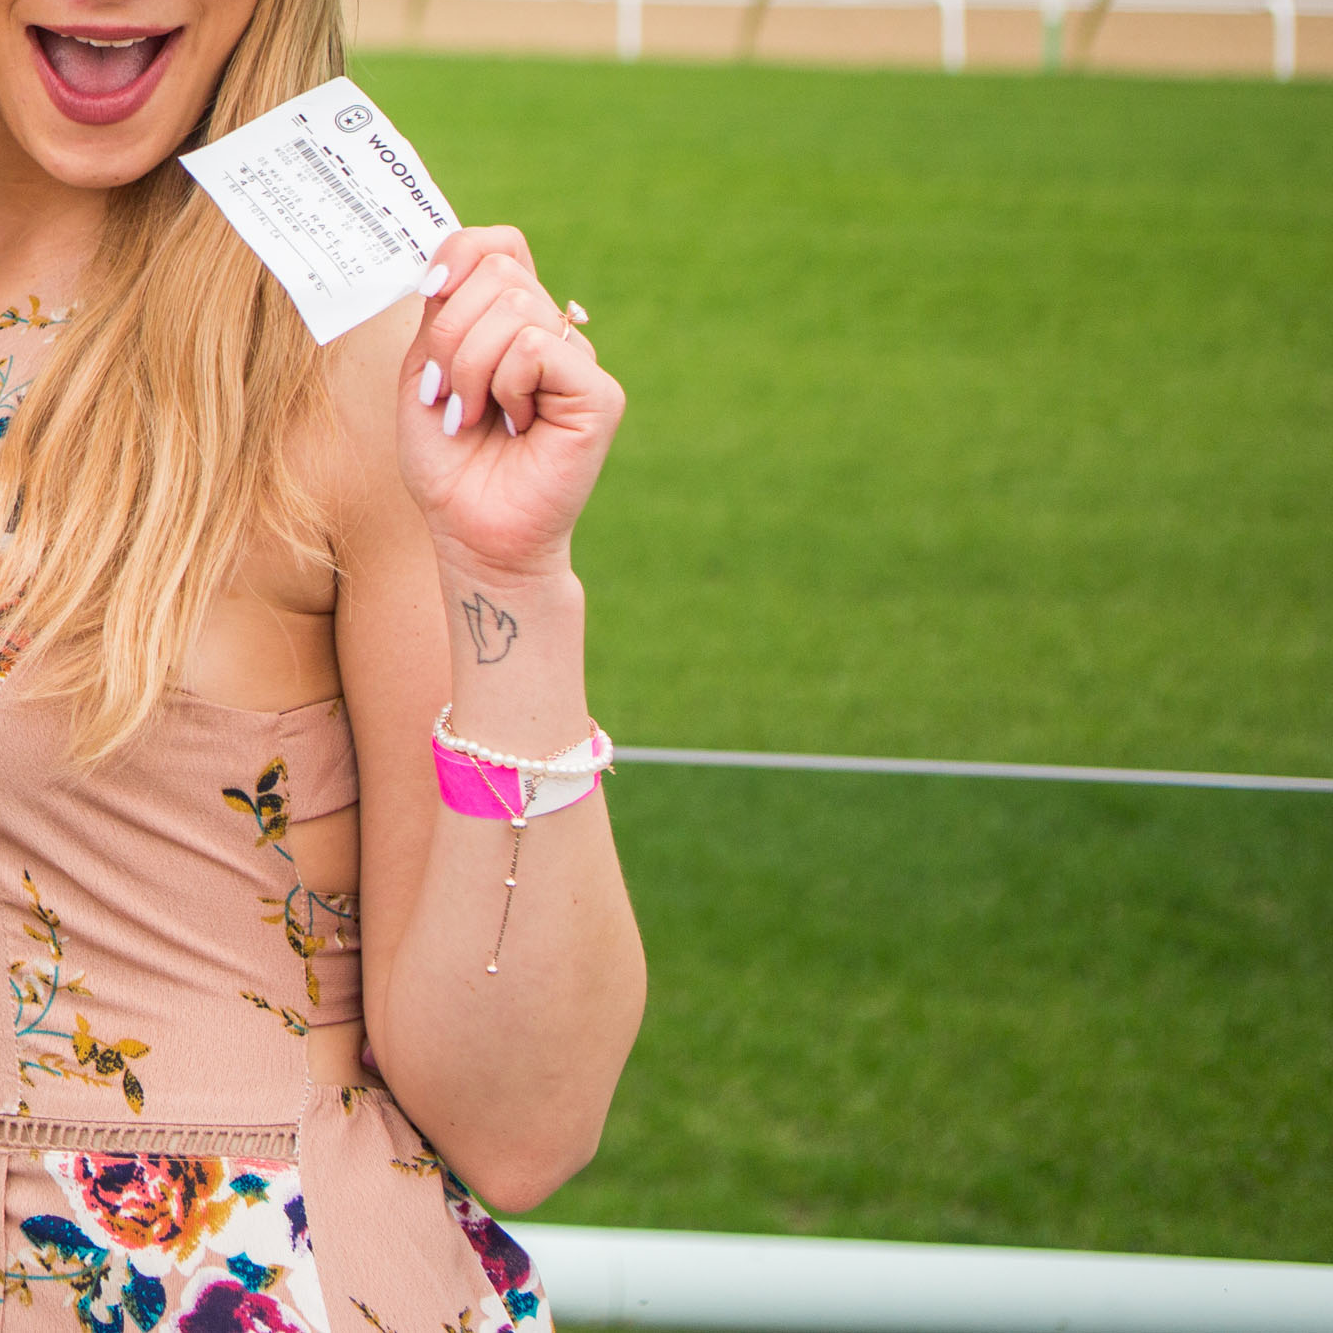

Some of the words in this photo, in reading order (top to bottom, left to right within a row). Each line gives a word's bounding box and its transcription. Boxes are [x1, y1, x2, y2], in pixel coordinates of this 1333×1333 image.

[255, 168, 317, 235] Woodbine
[368, 133, 448, 228] WOODBINE
[260, 189, 300, 232] Place
[308, 213, 343, 247] RACE
